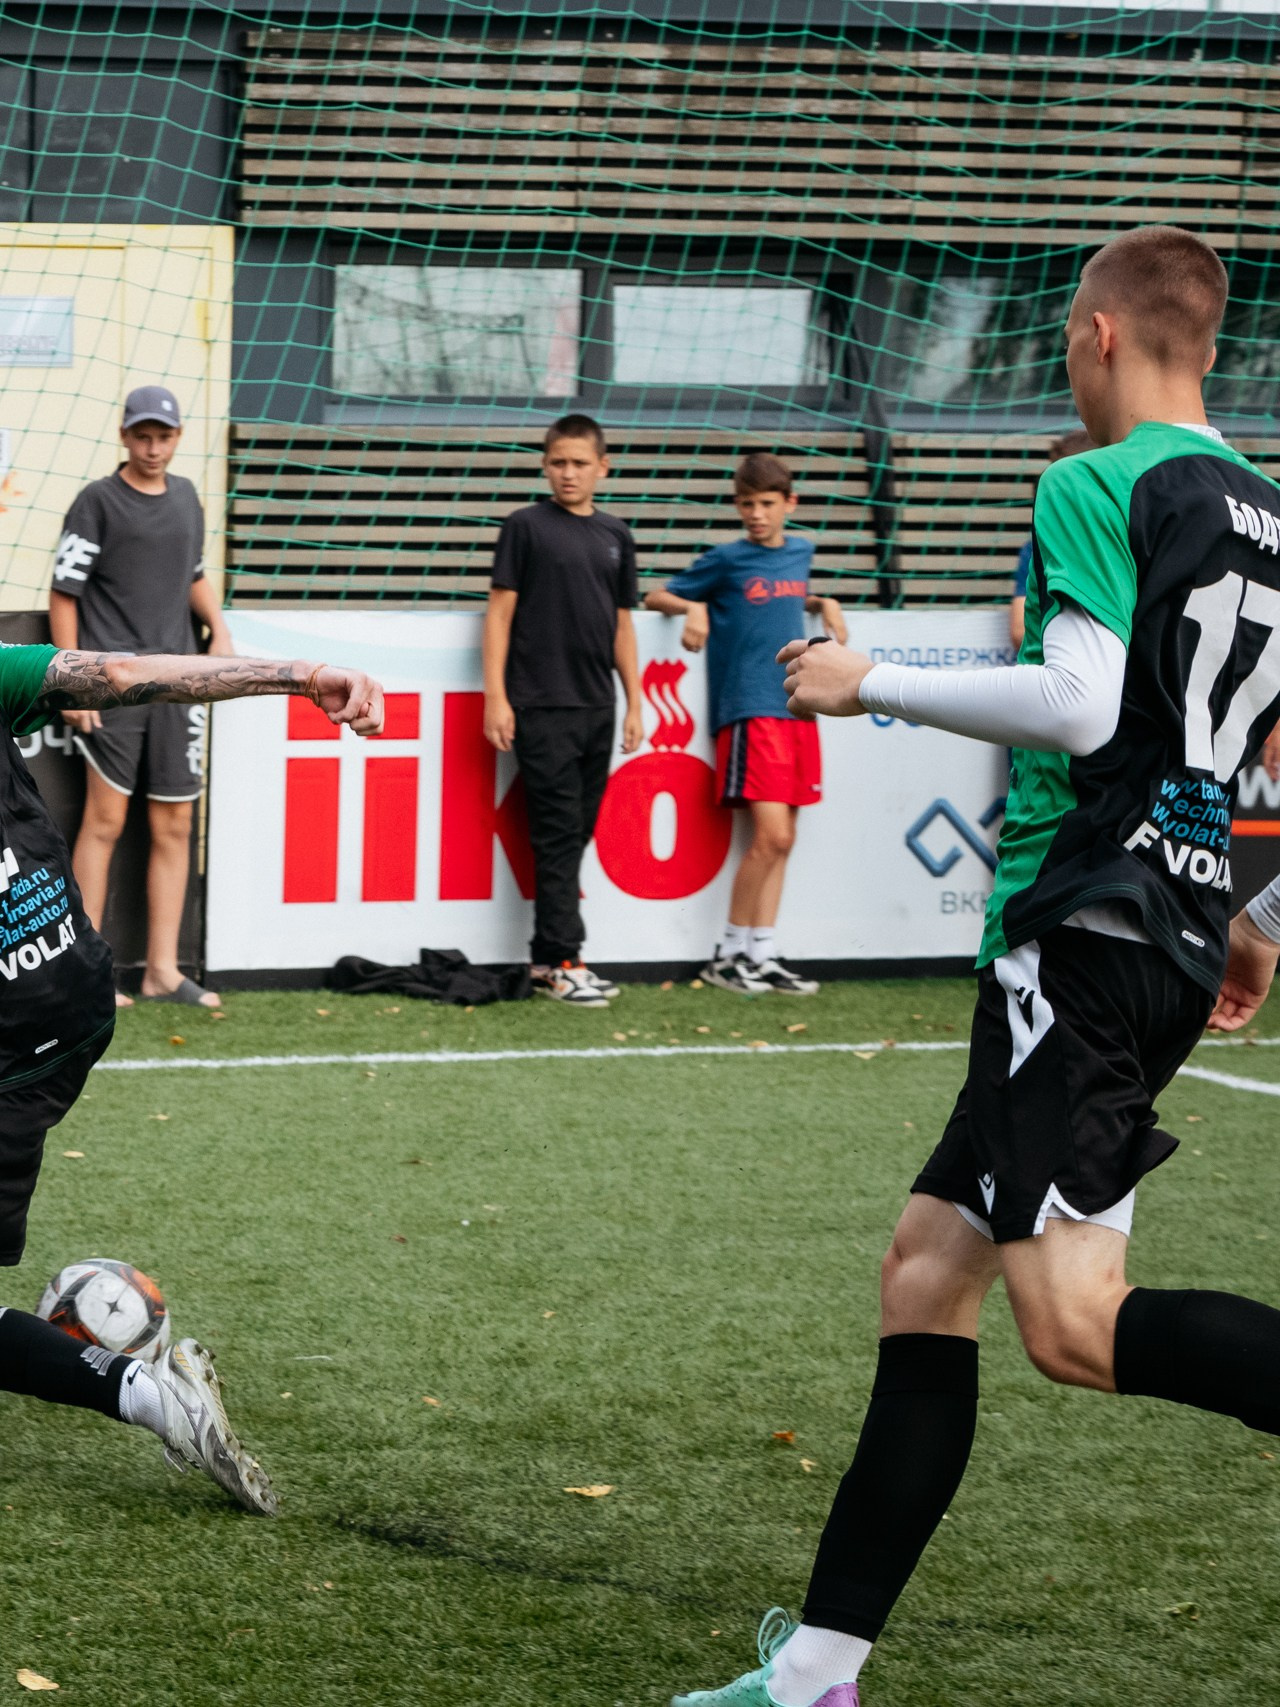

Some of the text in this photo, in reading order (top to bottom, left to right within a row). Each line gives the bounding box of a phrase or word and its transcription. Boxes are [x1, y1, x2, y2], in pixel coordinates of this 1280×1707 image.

[871, 648, 1018, 668] ПОДДЕРЖК
[1183, 570, 1280, 784] 17
[1163, 838, 1233, 893] VOLA
